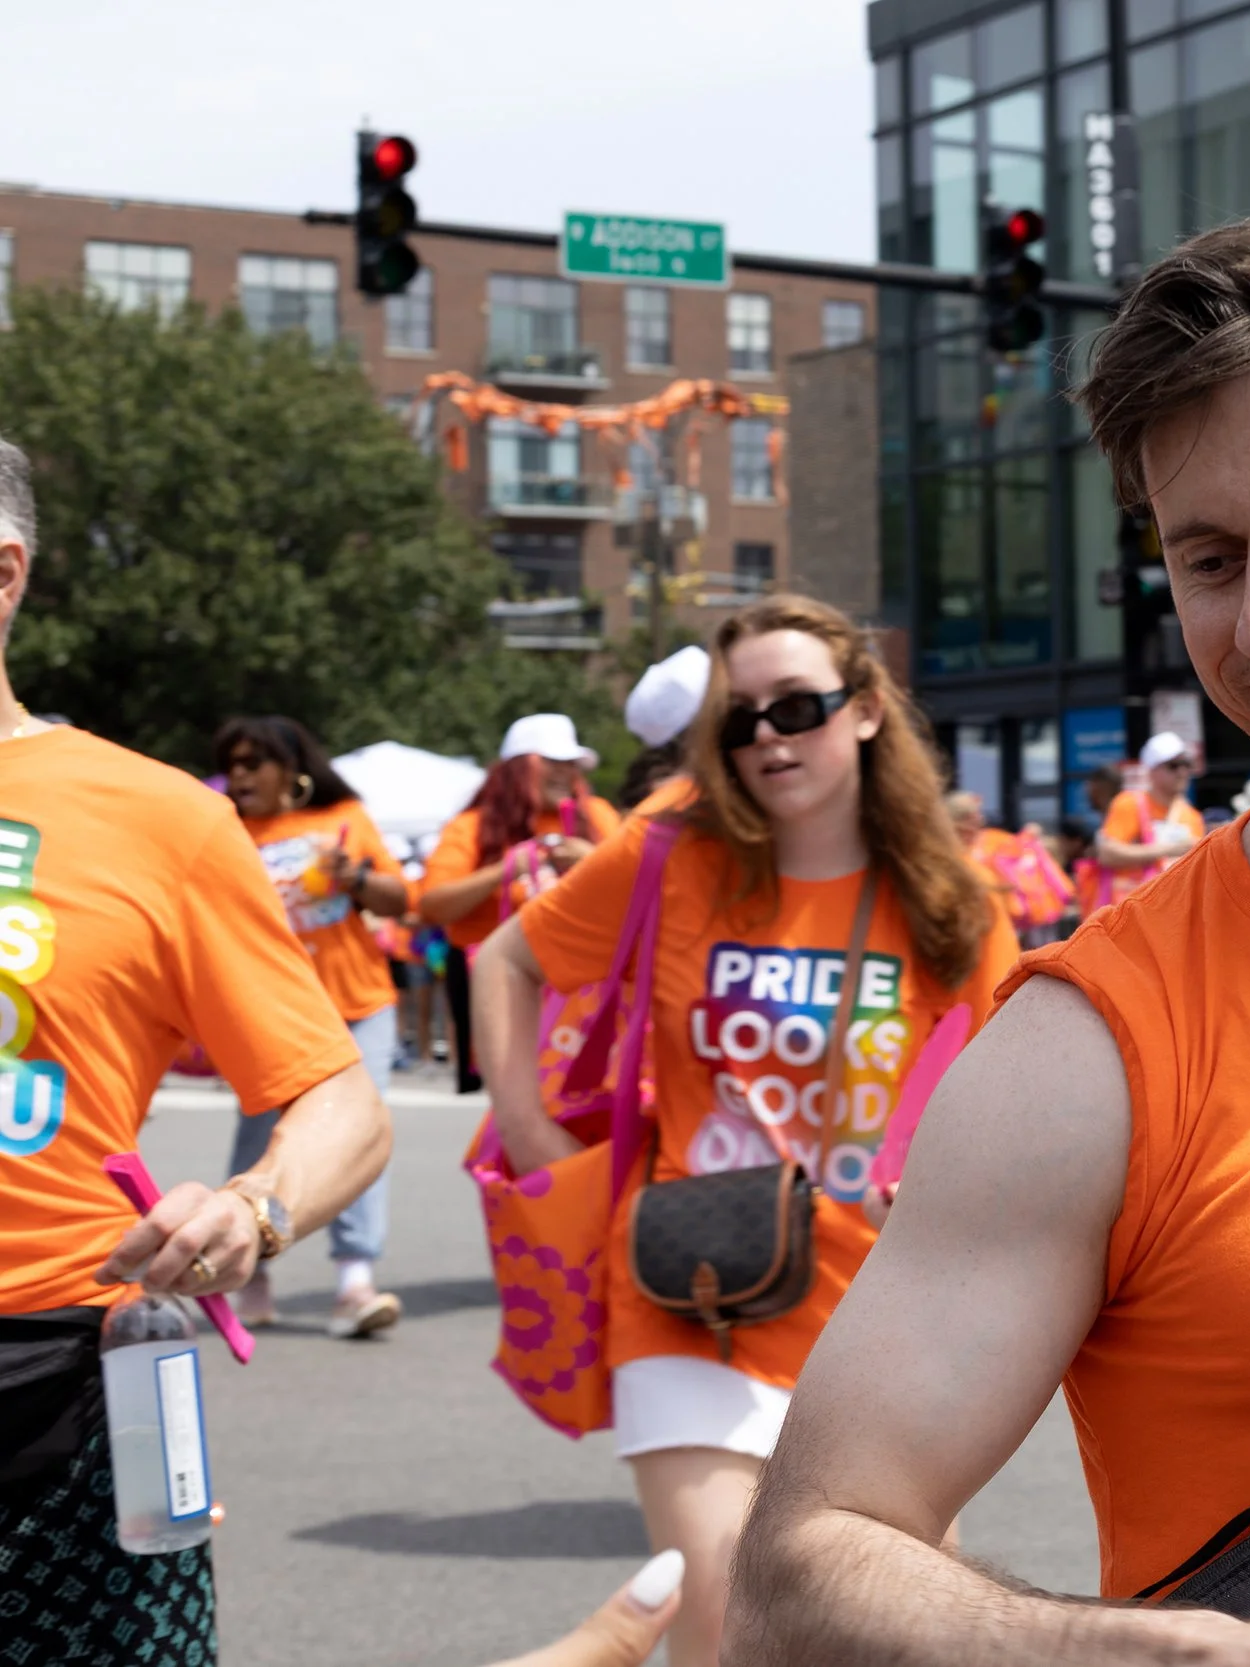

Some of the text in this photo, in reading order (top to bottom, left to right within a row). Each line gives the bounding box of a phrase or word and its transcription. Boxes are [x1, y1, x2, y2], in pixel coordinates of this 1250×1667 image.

[711, 949, 898, 1010] PRIDE
[690, 1007, 908, 1073] LOOKS
[713, 1071, 890, 1133] GOOD
[788, 1139, 886, 1192] YO
